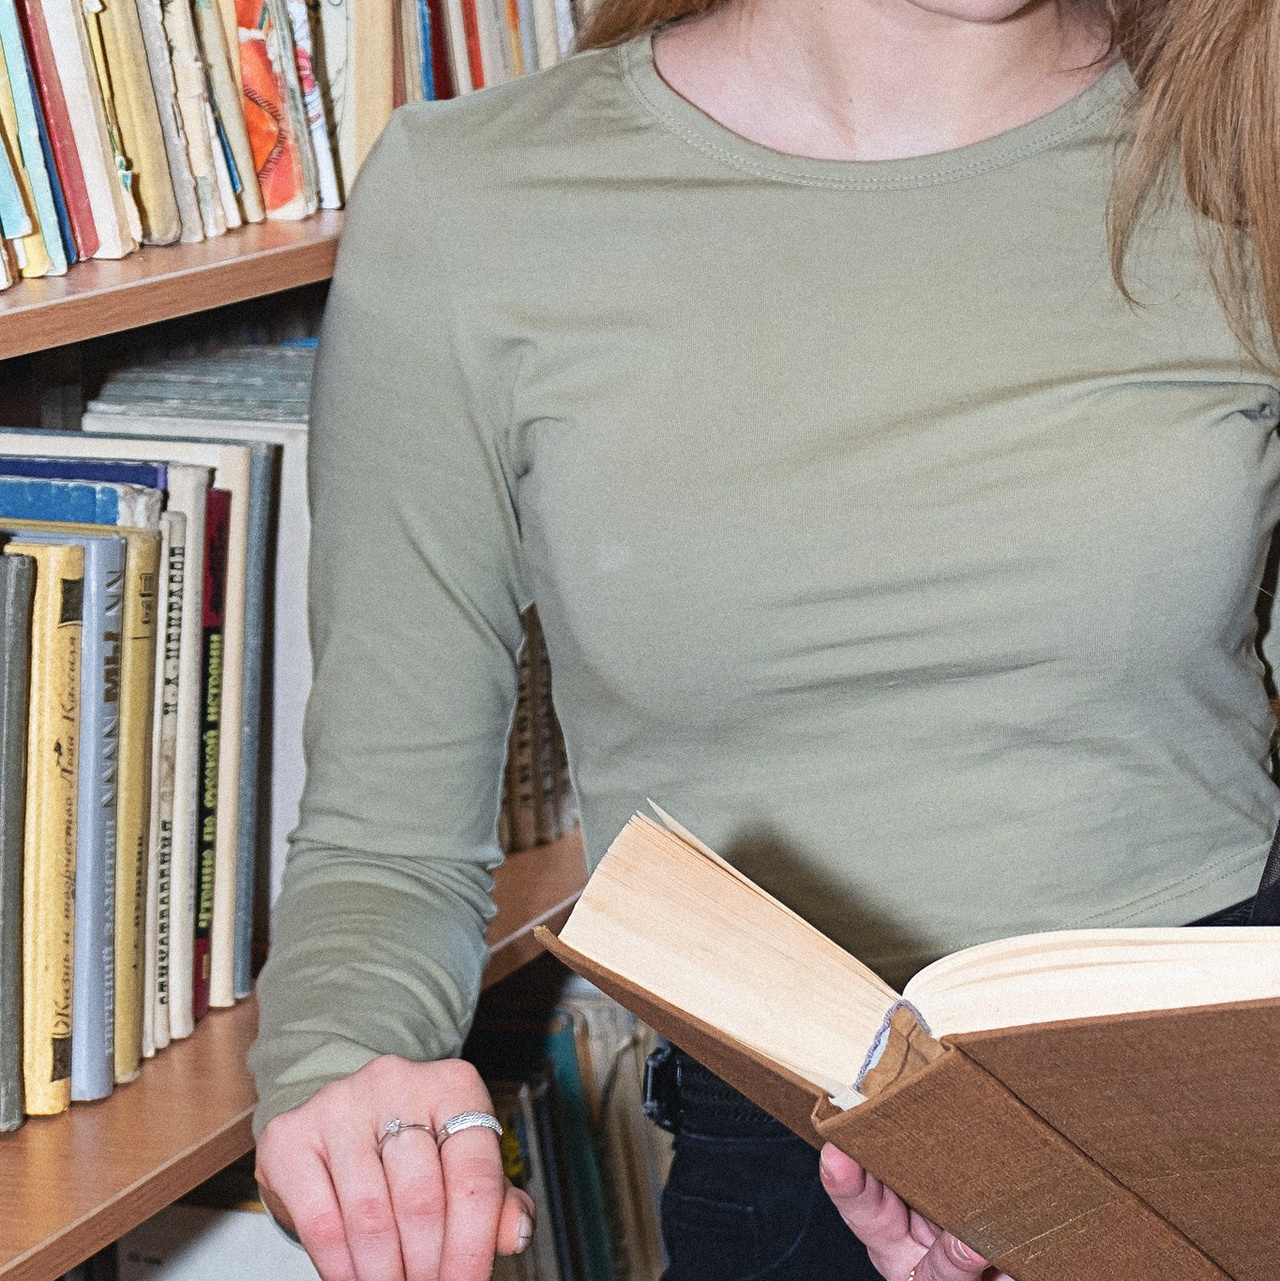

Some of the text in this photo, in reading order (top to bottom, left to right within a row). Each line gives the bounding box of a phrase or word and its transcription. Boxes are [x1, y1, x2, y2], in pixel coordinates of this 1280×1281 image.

[103, 631, 121, 703] МЫ
[54, 635, 76, 1036] Жизнь и творчество Льва Кассиля
